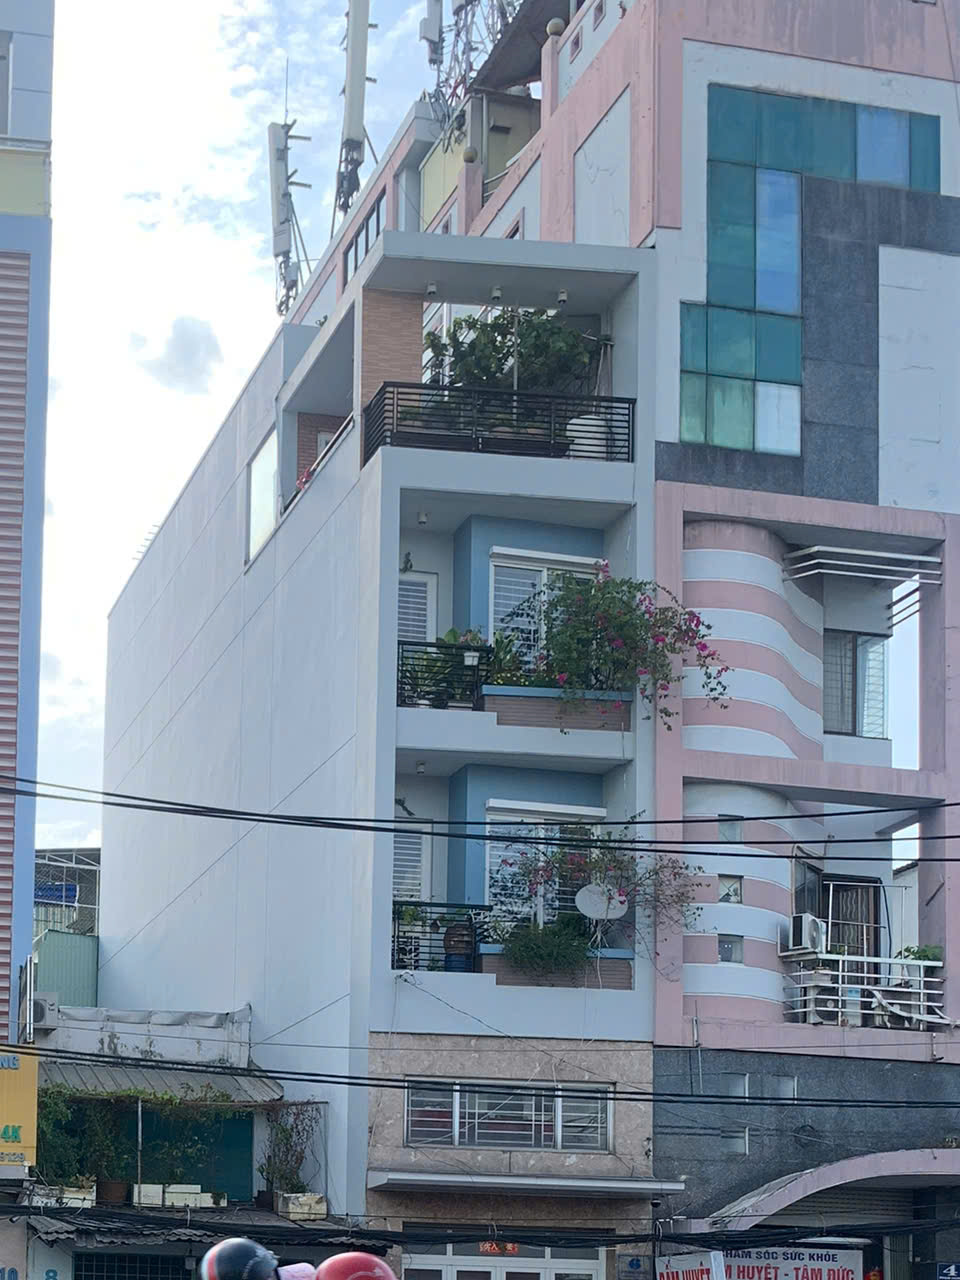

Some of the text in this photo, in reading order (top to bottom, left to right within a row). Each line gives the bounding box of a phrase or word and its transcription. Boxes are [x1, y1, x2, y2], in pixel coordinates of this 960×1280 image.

[783, 1250, 805, 1261] SỨC
[808, 1251, 838, 1262] KHỎE
[942, 1264, 958, 1277] 4
